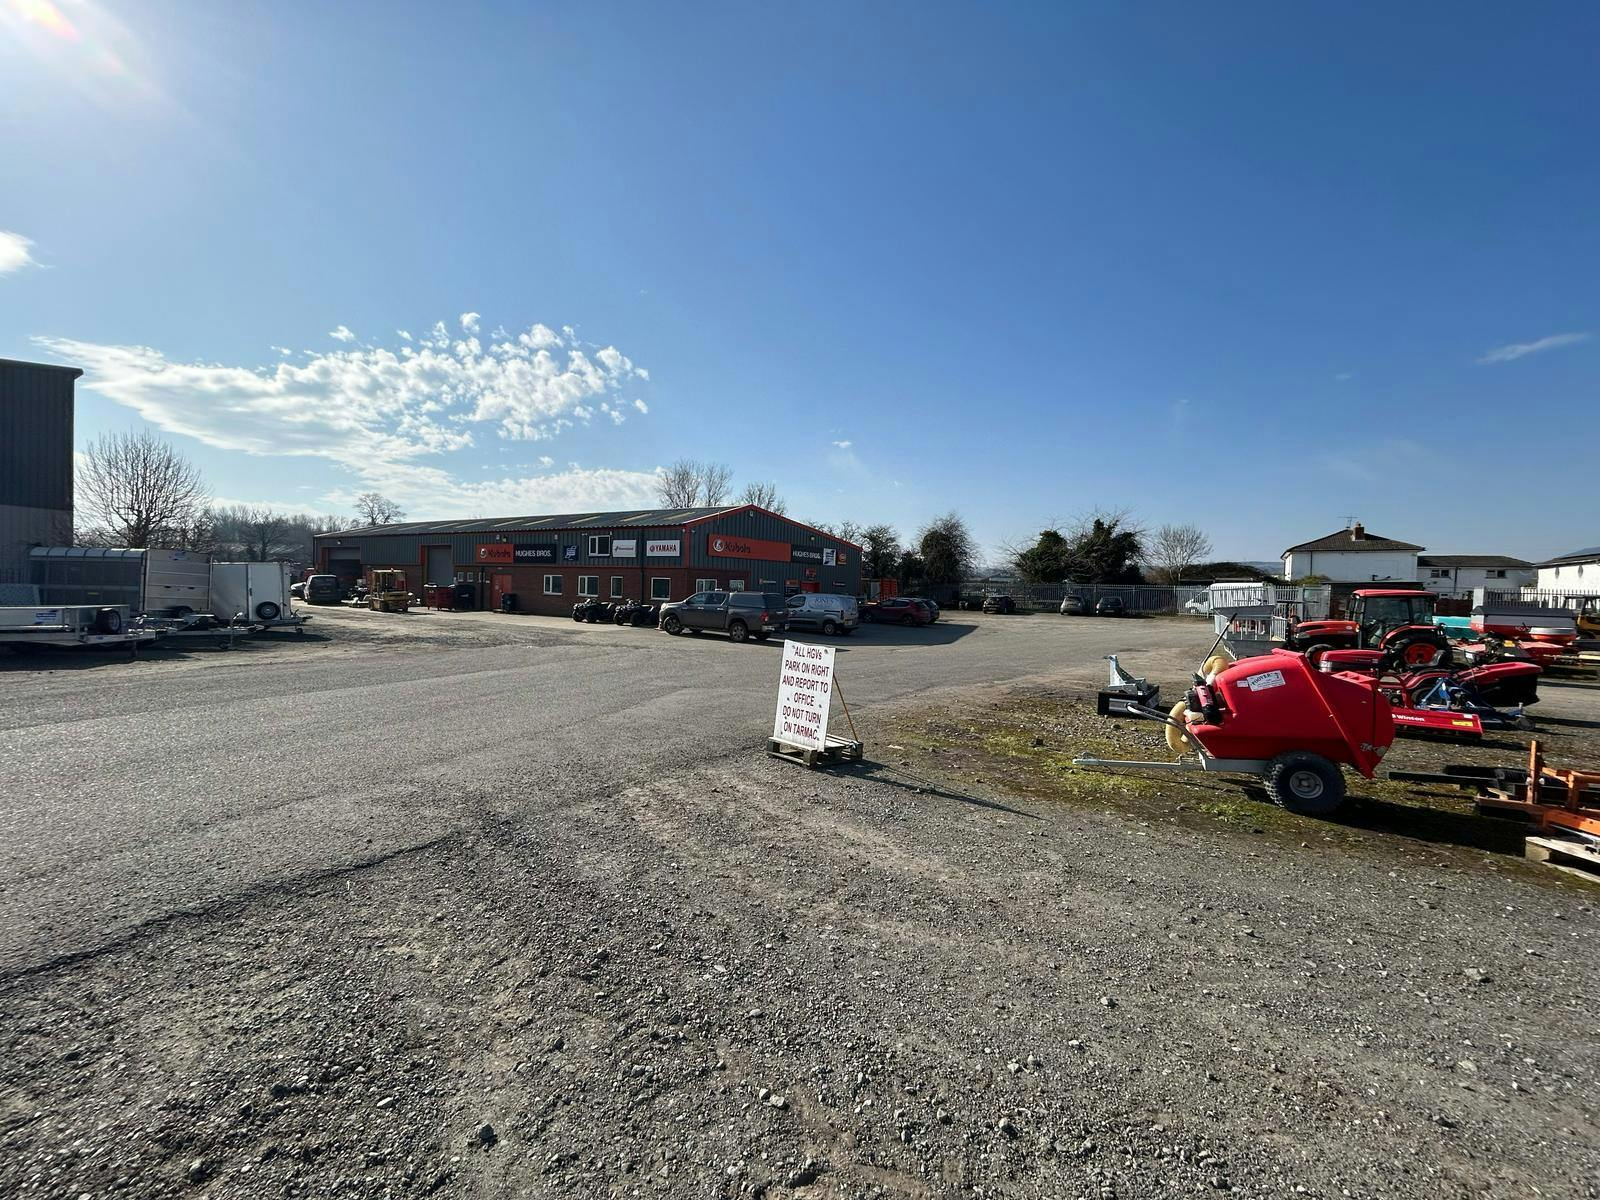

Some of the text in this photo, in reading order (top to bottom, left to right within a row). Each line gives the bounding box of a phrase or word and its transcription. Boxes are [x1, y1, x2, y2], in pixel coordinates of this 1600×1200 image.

[515, 549, 535, 557] HUGHES
[655, 544, 677, 552] YAMAHA
[794, 646, 805, 658] ALL
[785, 660, 829, 677] PARK ON RIGHT
[782, 674, 829, 693] AND REPORT TO
[793, 692, 815, 706] OFFICE
[782, 705, 821, 724] DO NOT TURN
[783, 721, 817, 739] ON TARMAC
